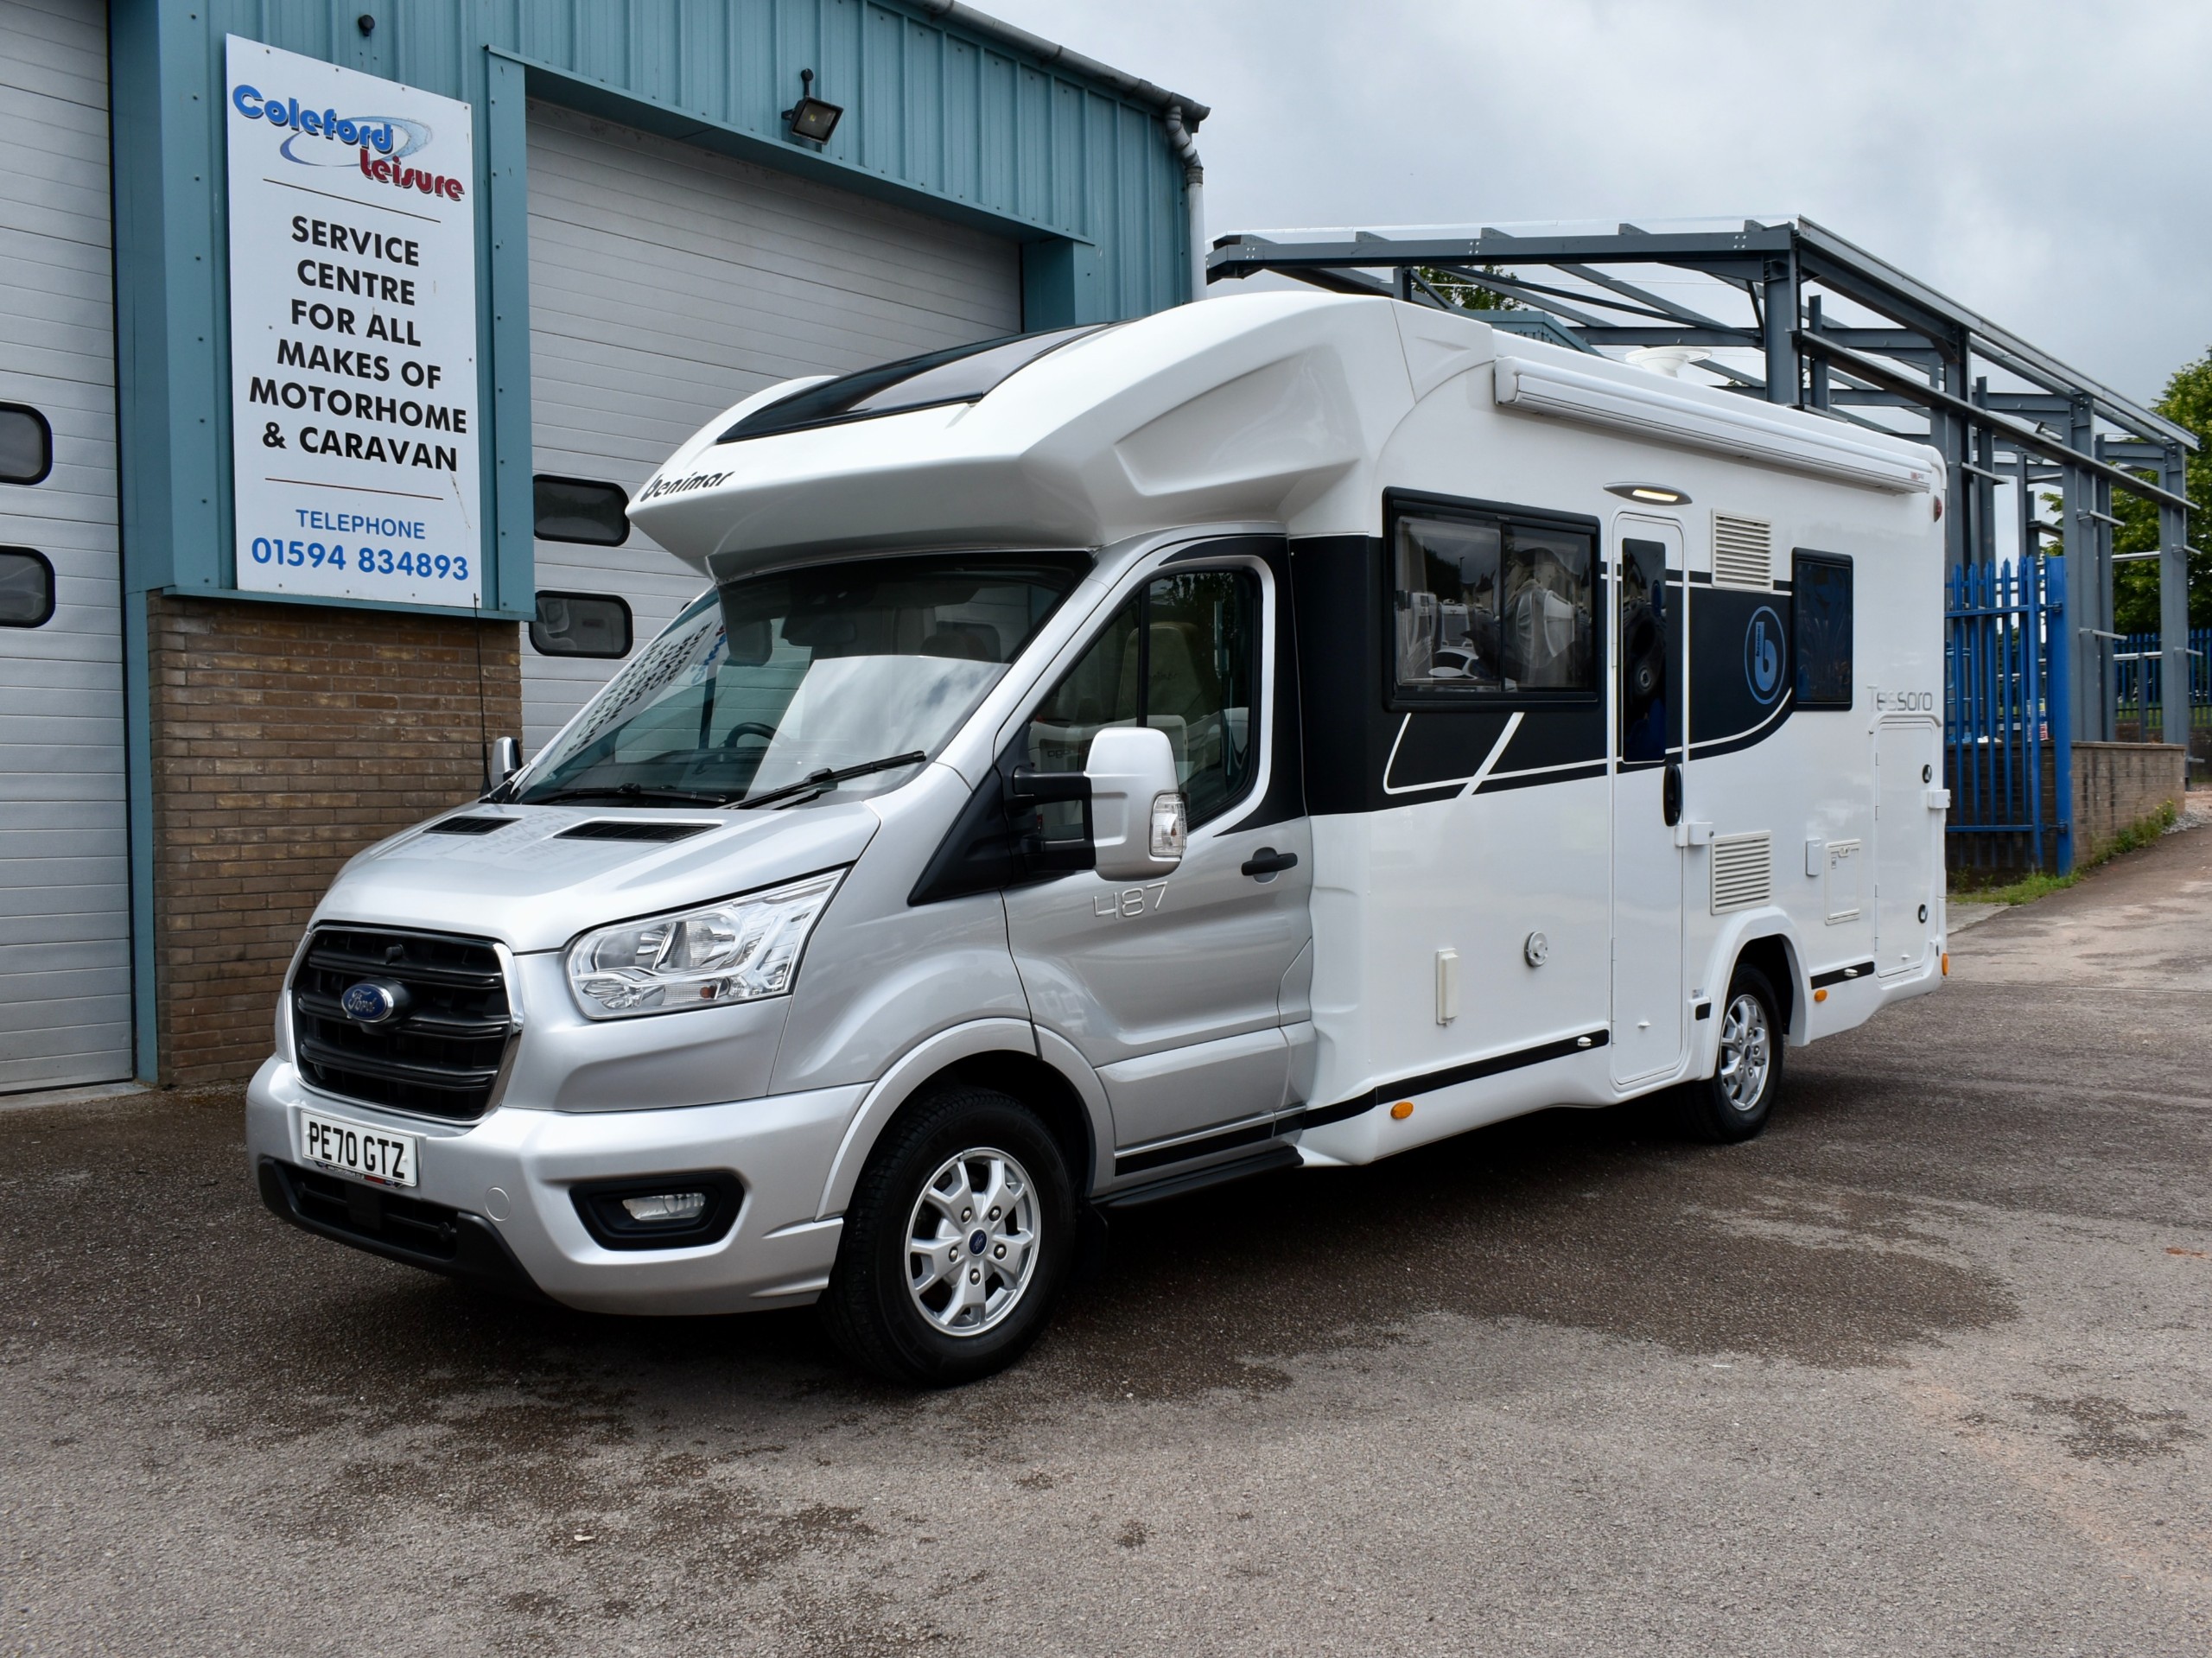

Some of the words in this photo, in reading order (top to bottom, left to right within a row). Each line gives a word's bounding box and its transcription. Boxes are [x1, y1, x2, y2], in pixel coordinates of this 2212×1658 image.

[232, 84, 394, 153] Coleford
[359, 148, 465, 201] Leisure
[291, 215, 419, 267] SERVICE
[296, 259, 416, 306] CENTRE
[291, 298, 356, 335] FOR
[365, 314, 422, 347] ALL
[276, 339, 390, 382] MAKES
[401, 360, 442, 390] OF
[249, 376, 467, 434] MOTORHOME
[262, 422, 287, 449] &
[299, 426, 457, 472] CARAVAN
[296, 509, 425, 539] TELEPHONE
[251, 537, 346, 570] 01594
[358, 548, 469, 581] 834893
[1093, 880, 1168, 919] 487
[348, 988, 377, 1013] Ford
[308, 1121, 358, 1167] PE70
[363, 1135, 405, 1179] GTZ
